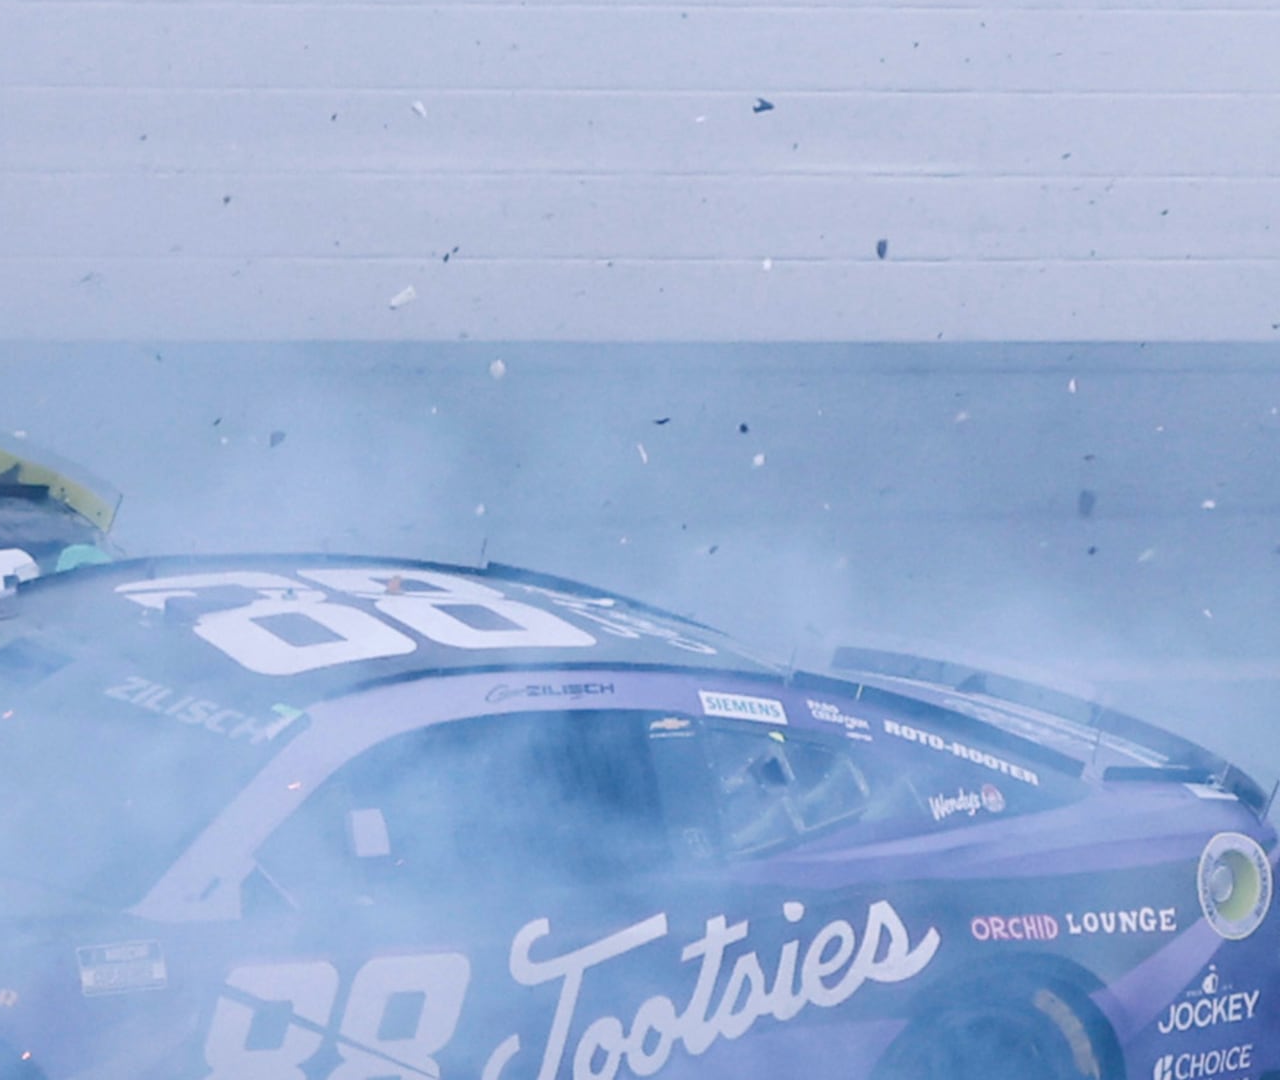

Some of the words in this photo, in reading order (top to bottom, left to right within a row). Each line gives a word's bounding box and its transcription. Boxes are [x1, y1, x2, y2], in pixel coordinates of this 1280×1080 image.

[115, 569, 597, 675] 88
[706, 695, 781, 719] SIEMENS
[883, 720, 1039, 786] ROTO-ROOTER
[971, 915, 1059, 941] ORCHID
[1067, 907, 1177, 935] LOUNGE
[482, 901, 940, 1080] Tootsies
[1158, 989, 1260, 1034] JOCKEY
[1175, 1044, 1253, 1080] CHOICE
